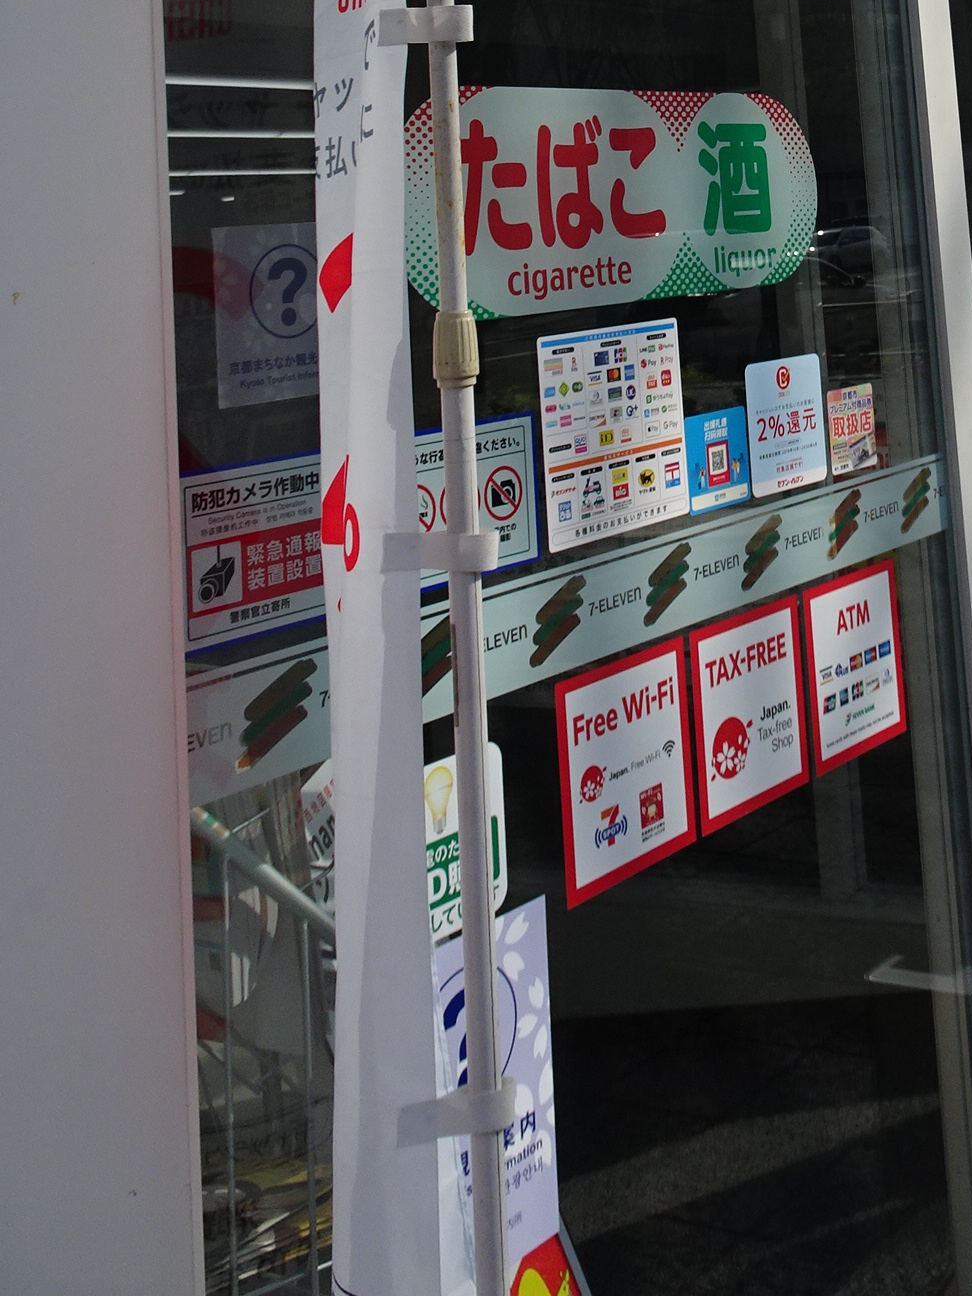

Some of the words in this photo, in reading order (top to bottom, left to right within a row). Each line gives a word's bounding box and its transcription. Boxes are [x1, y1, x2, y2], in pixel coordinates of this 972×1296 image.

[461, 115, 667, 256] たばこ
[698, 121, 772, 235] 酒
[507, 256, 632, 300] cigarette
[714, 245, 777, 278] liquor
[756, 407, 817, 443] 2%還元
[832, 410, 872, 439] 取扱店
[191, 470, 320, 514] 防犯カメラ作動中
[246, 531, 322, 565] 緊急通報
[247, 553, 322, 592] 装置設置
[230, 598, 291, 624] 警察官立寄所
[836, 599, 871, 636] ATM
[704, 632, 788, 689] TAX-FREE
[572, 707, 618, 747] Free
[622, 676, 675, 725] Wi-Fi
[760, 699, 791, 721] Japan.
[757, 717, 793, 742] Tax-free
[771, 733, 794, 753] Shop
[630, 758, 645, 771] Free
[645, 749, 661, 764] Wi-Fi
